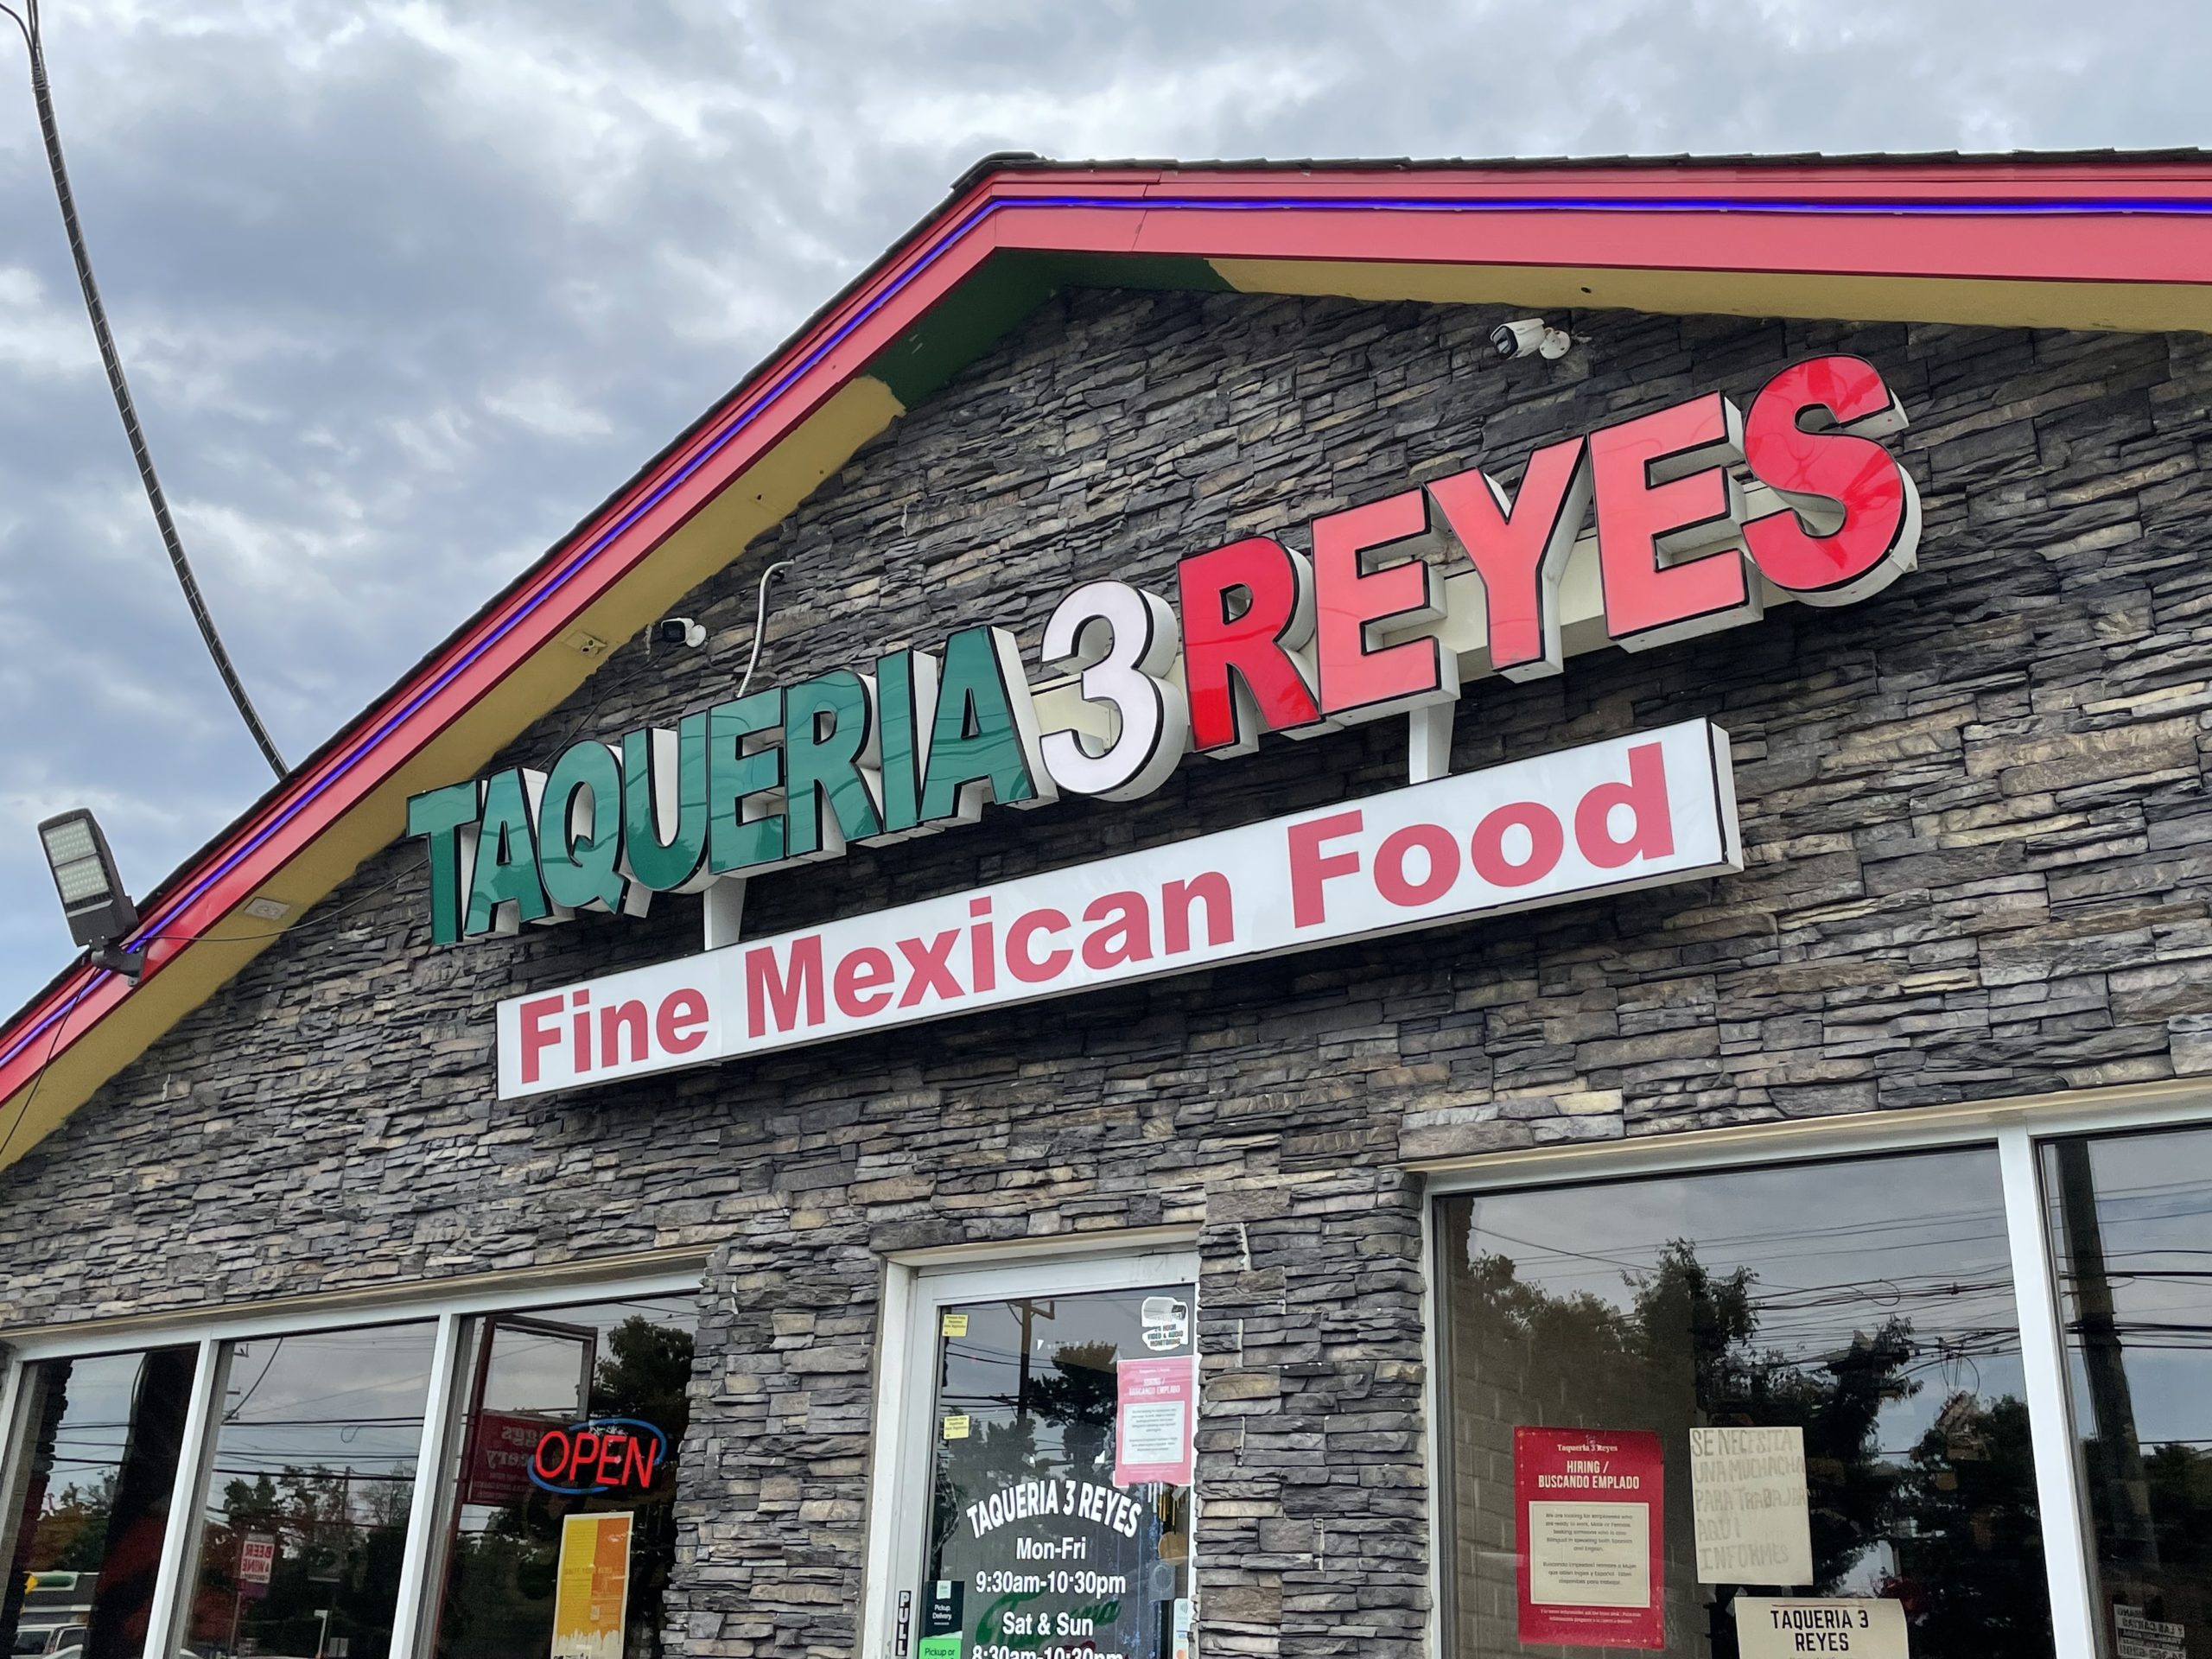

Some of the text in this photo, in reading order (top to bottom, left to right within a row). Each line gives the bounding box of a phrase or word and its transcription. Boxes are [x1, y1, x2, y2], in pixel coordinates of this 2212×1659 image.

[406, 353, 1906, 946] TAQUERIA 3 REYES
[518, 741, 1675, 1085] Fine Mexican Food
[1557, 1444, 1590, 1453] Taqueria
[1597, 1444, 1618, 1453] Reyes
[1691, 1428, 1794, 1457] SE NECESITA
[535, 1430, 658, 1489] OPEN
[1567, 1460, 1610, 1474] HIRING /
[1693, 1460, 1728, 1484] UNA
[1538, 1475, 1640, 1490] BUSCANDO EMPLADO
[966, 1479, 1142, 1539] TAQUERIA 3 REYES
[1694, 1488, 1733, 1513] PARA
[1015, 1535, 1086, 1560] Mon-Fri
[897, 1591, 910, 1656] PULL
[1002, 1611, 1033, 1636] Sat
[1037, 1611, 1051, 1636] &
[1056, 1611, 1094, 1637] Sun
[1770, 1609, 1869, 1630] TAQUERIA 3
[925, 1647, 947, 1657] Pickup
[1795, 1631, 1849, 1652] REYES
